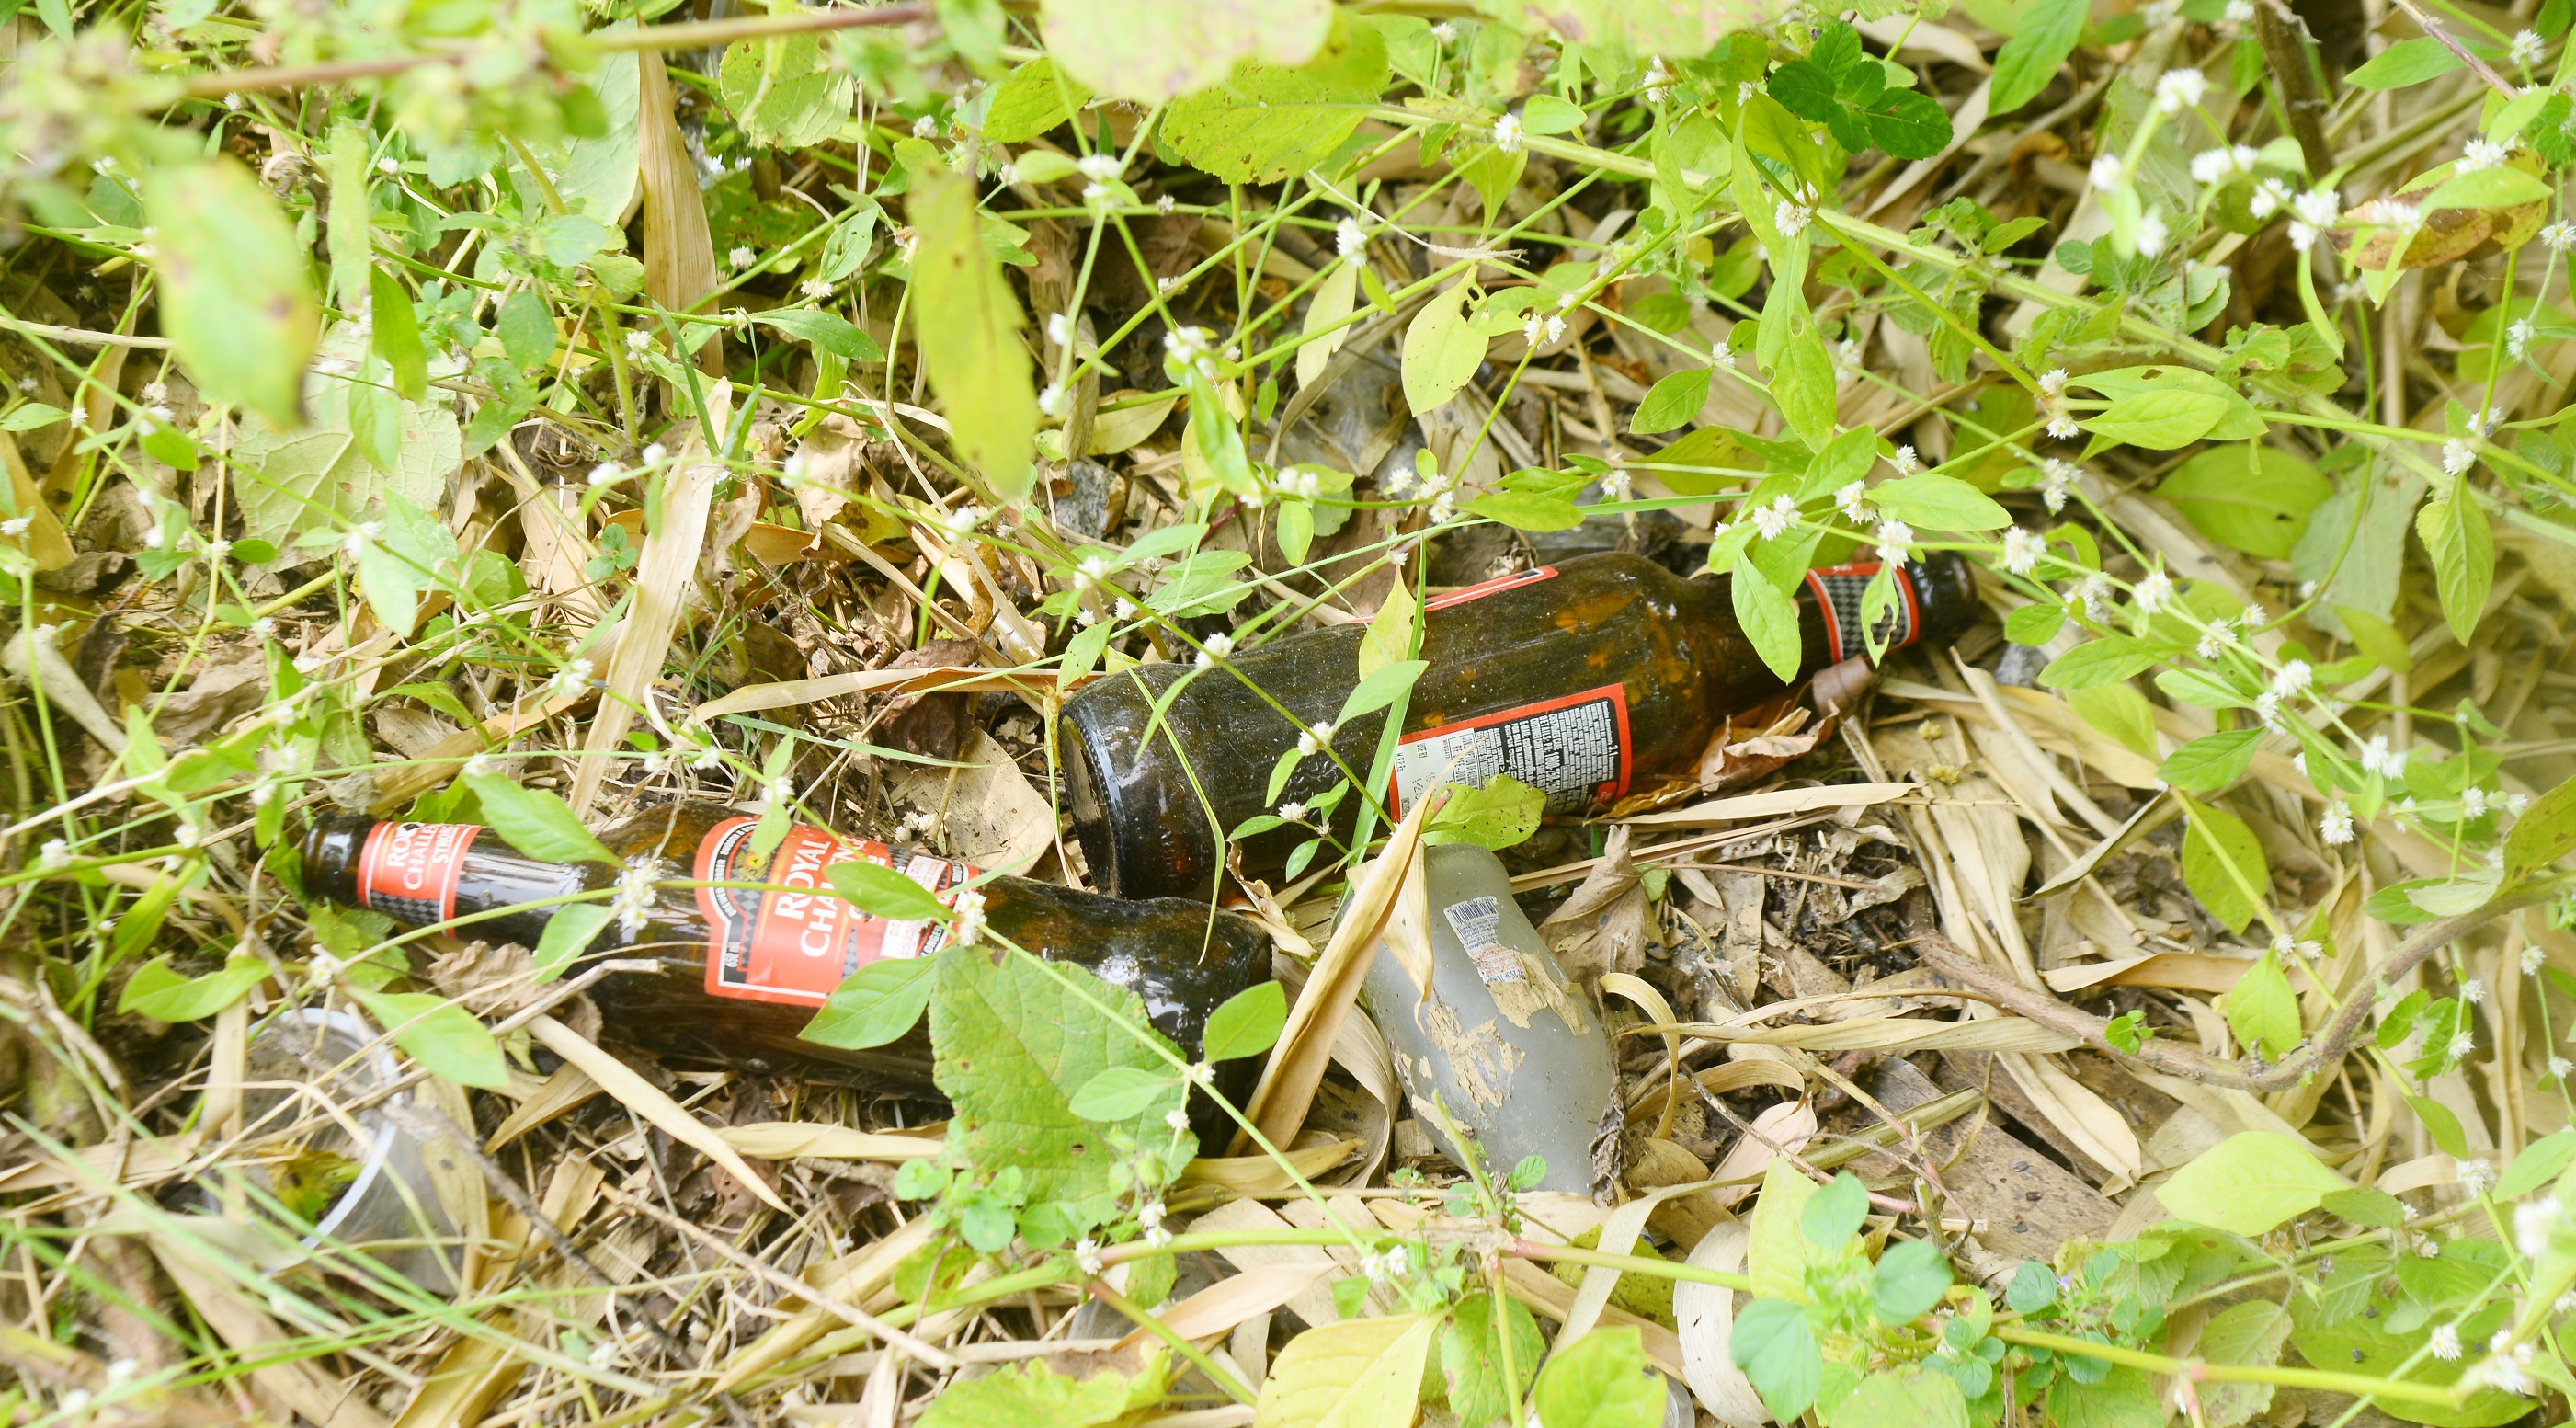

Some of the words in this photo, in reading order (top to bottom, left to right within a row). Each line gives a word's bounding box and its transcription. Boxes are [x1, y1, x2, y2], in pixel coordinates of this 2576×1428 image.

[1609, 745, 1618, 756] 3.1
[714, 859, 726, 882] ONGER
[774, 840, 832, 920] ROYAL
